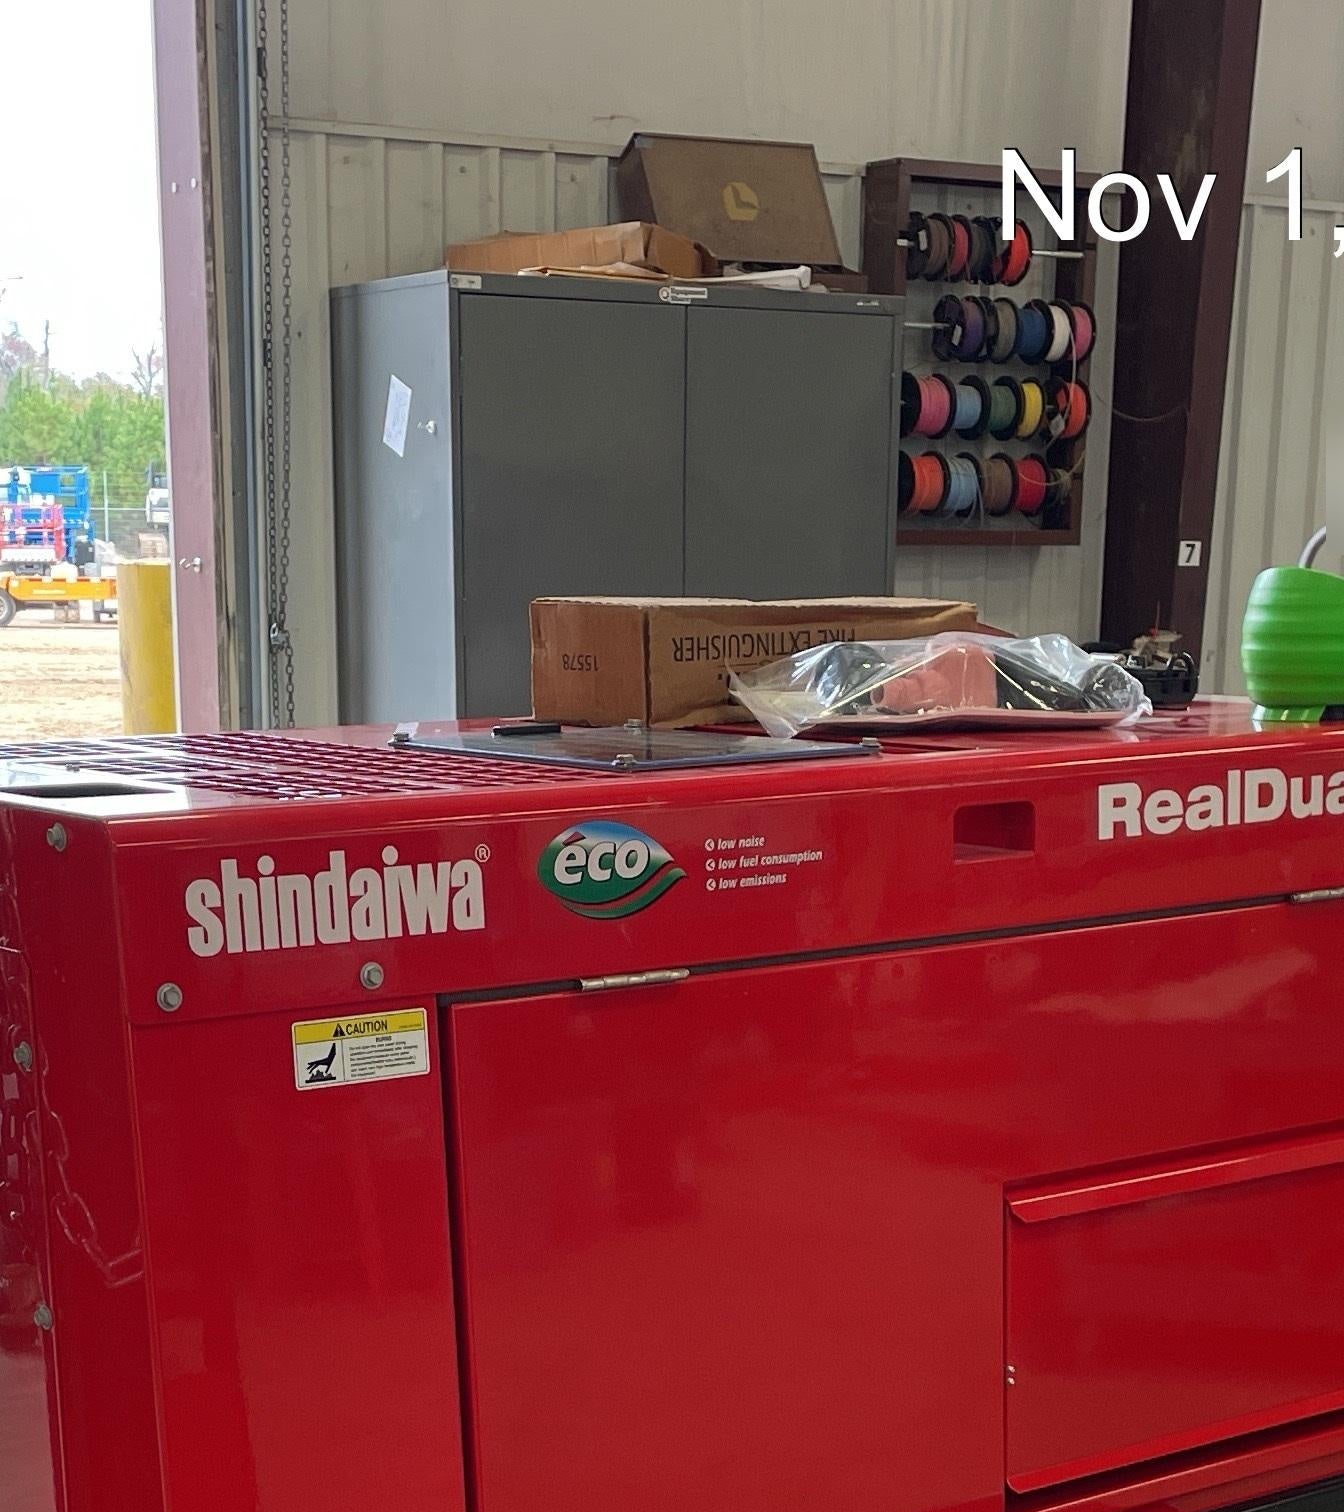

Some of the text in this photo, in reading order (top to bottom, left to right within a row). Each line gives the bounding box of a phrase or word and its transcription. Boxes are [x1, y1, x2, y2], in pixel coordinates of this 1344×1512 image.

[1185, 543, 1196, 564] 7
[671, 630, 811, 662] EXTINGUISHER
[562, 653, 600, 672] 15578
[717, 835, 765, 850] low noise
[718, 850, 823, 870] low fuel consumption
[718, 873, 787, 889] low emissions
[345, 1020, 388, 1036] CAUTION
